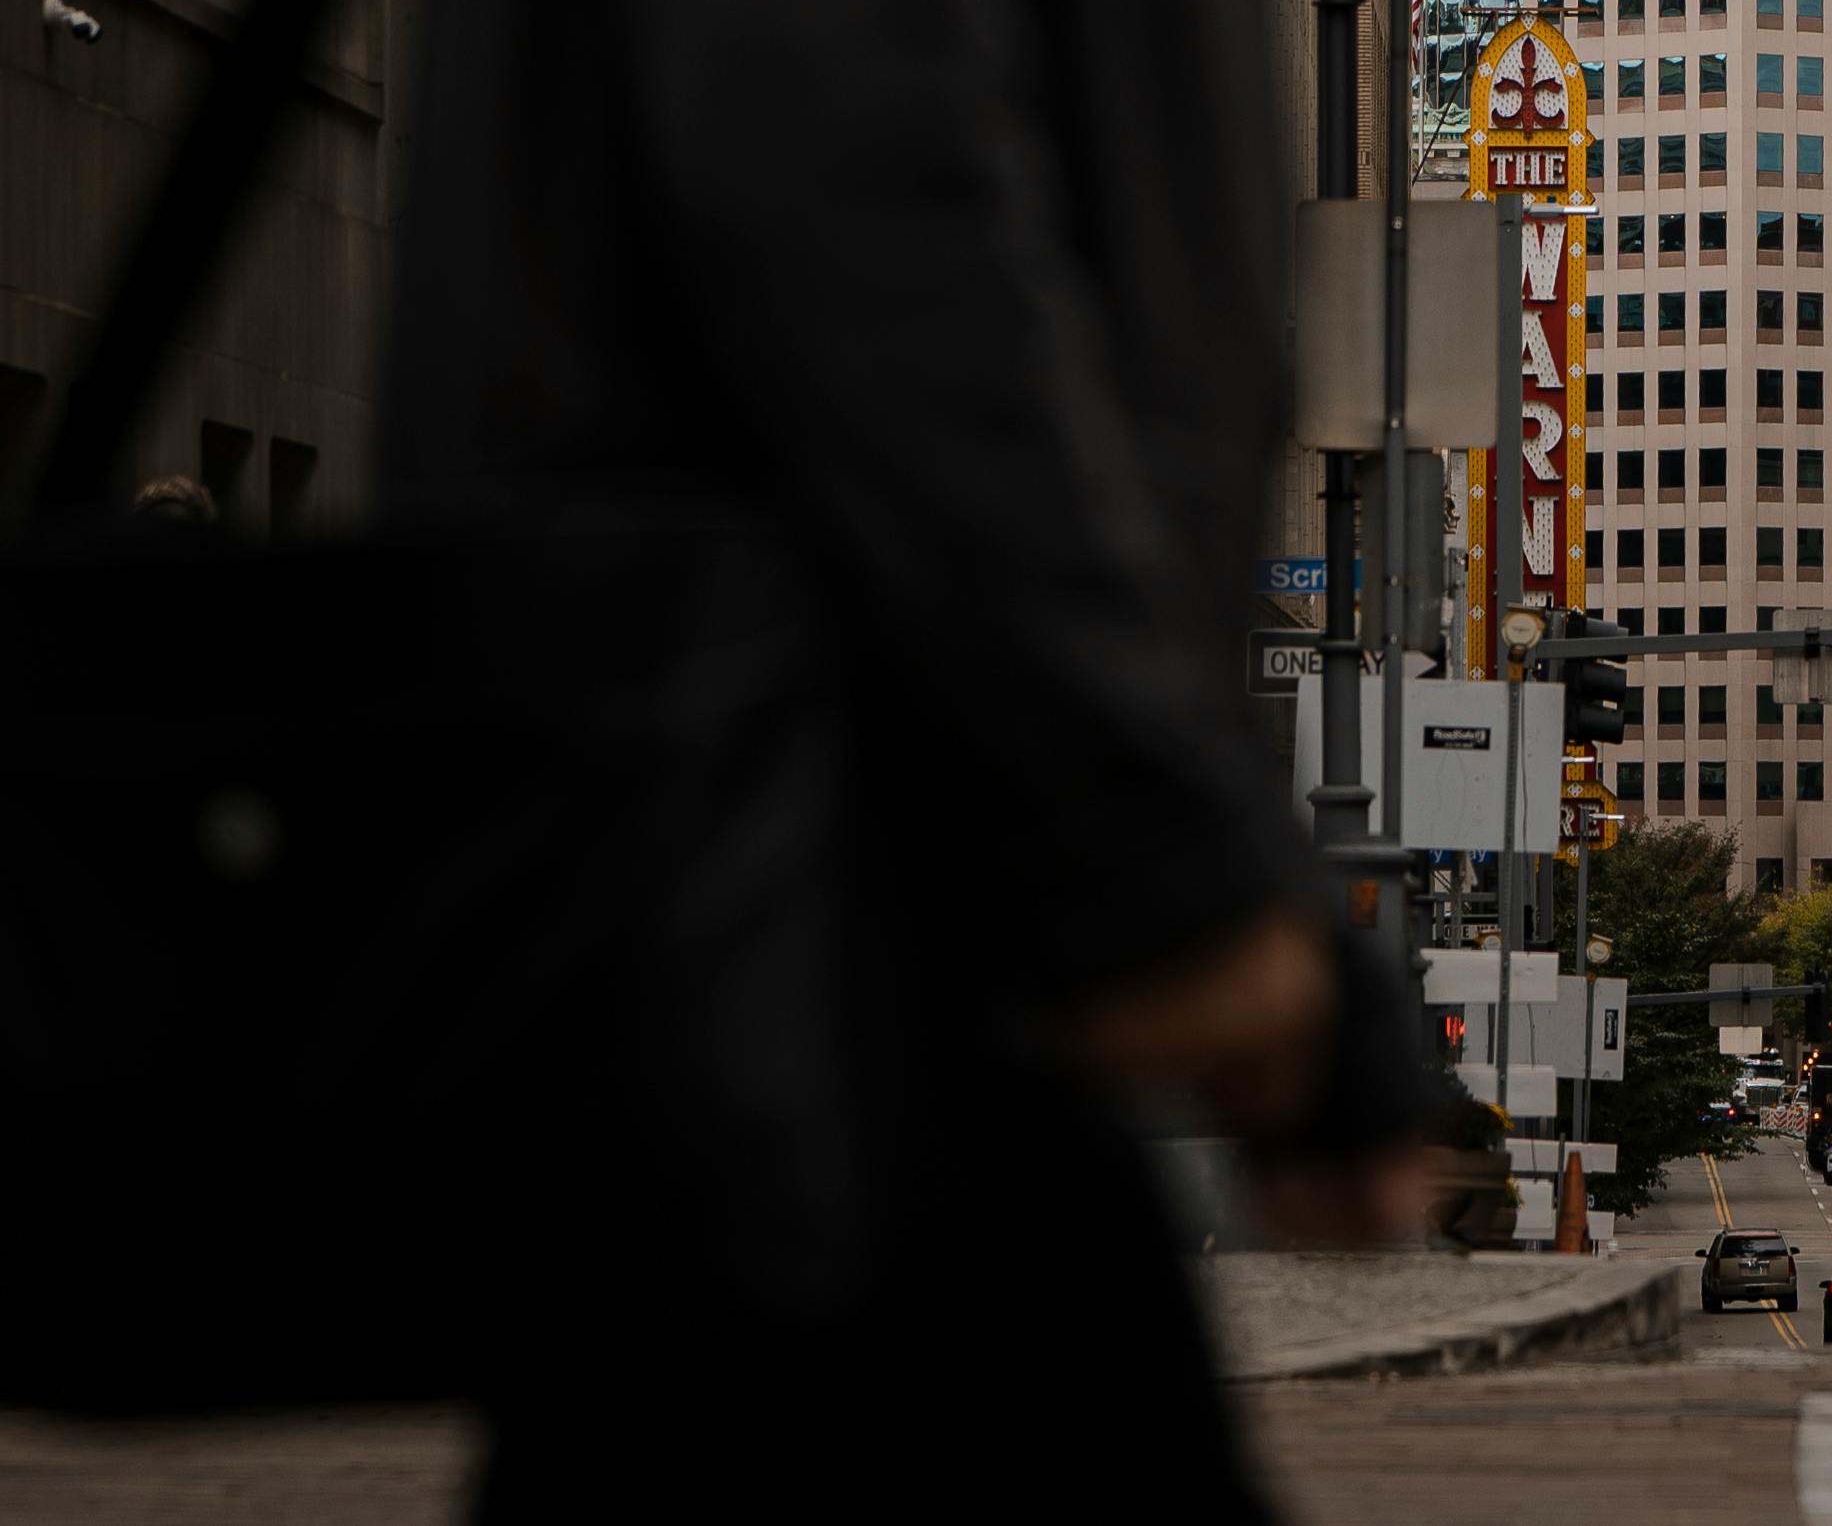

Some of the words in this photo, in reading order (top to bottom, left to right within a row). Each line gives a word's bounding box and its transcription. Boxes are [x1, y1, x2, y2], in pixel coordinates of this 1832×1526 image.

[1490, 152, 1565, 185] THE
[1521, 220, 1566, 608] WARN
[1270, 563, 1328, 589] Scri
[1271, 651, 1323, 674] ONE
[1359, 650, 1386, 675] AY
